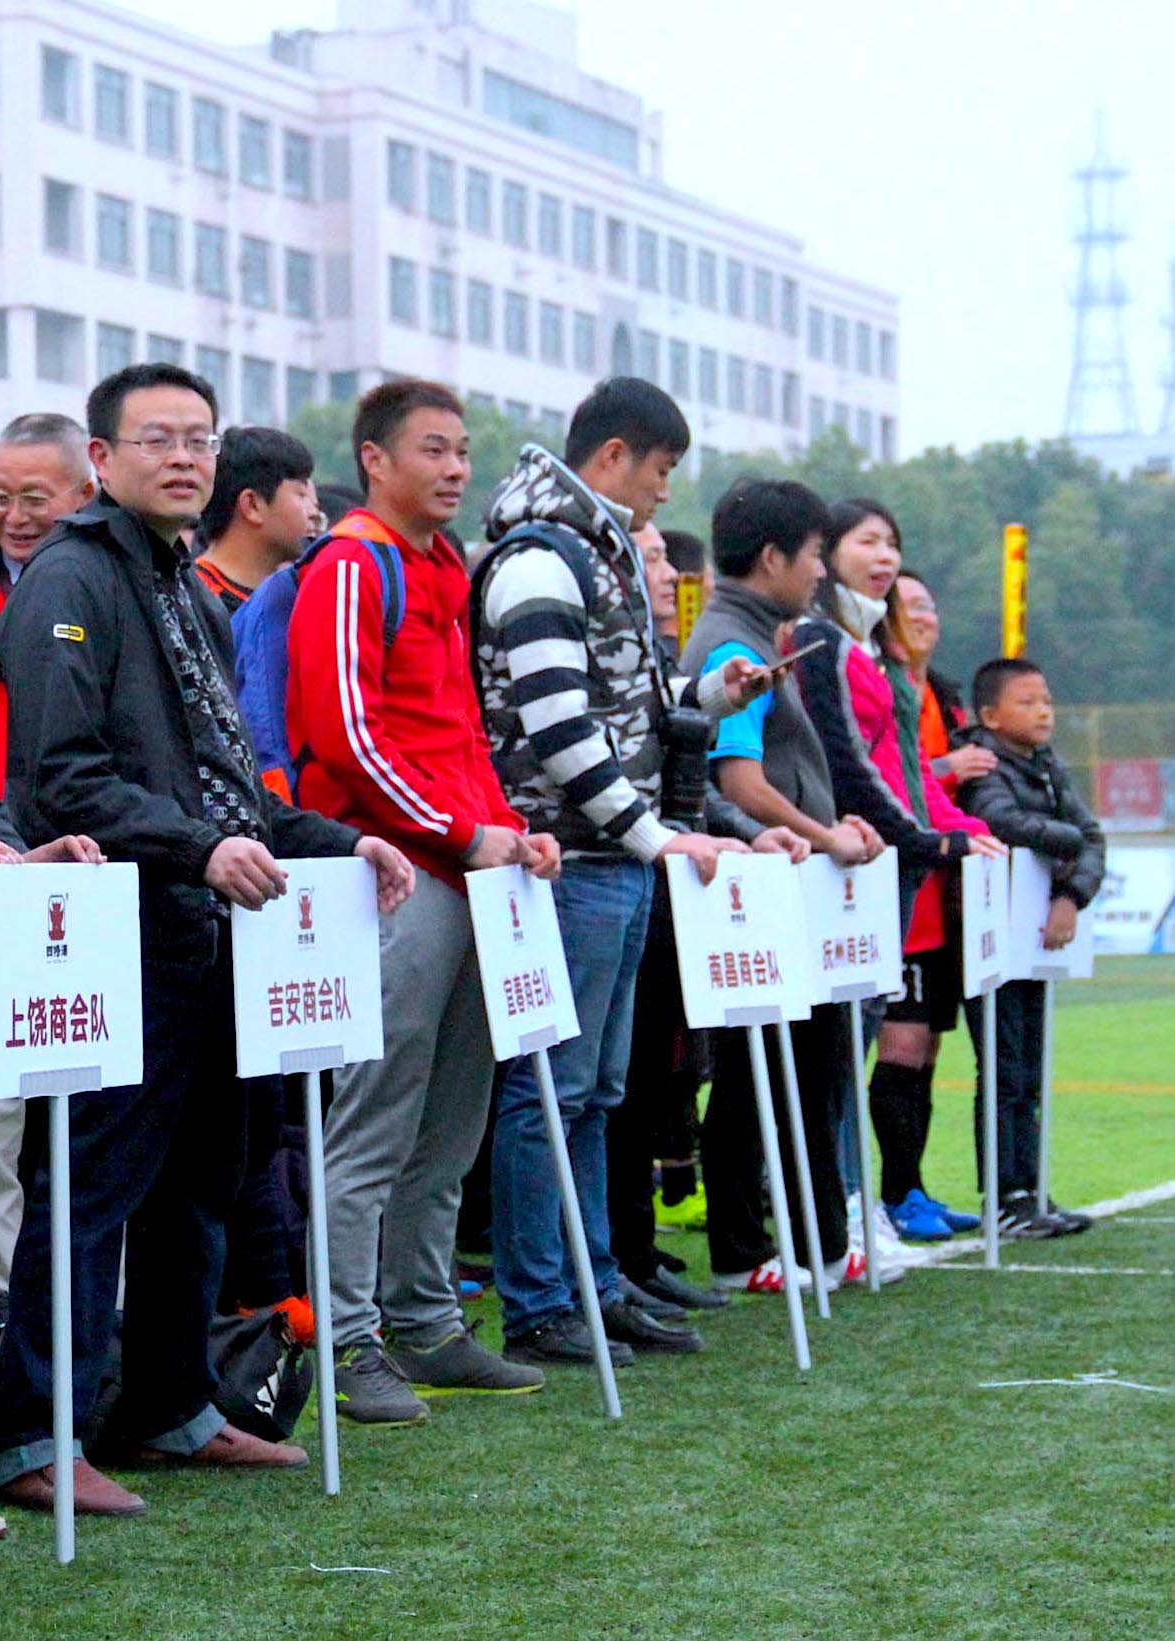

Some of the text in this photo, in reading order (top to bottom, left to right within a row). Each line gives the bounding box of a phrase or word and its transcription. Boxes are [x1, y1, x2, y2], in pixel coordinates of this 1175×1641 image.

[708, 949, 783, 989] 南昌商会队
[5, 992, 109, 1048] 上饶商会队
[267, 976, 352, 1028] 吉安商会队
